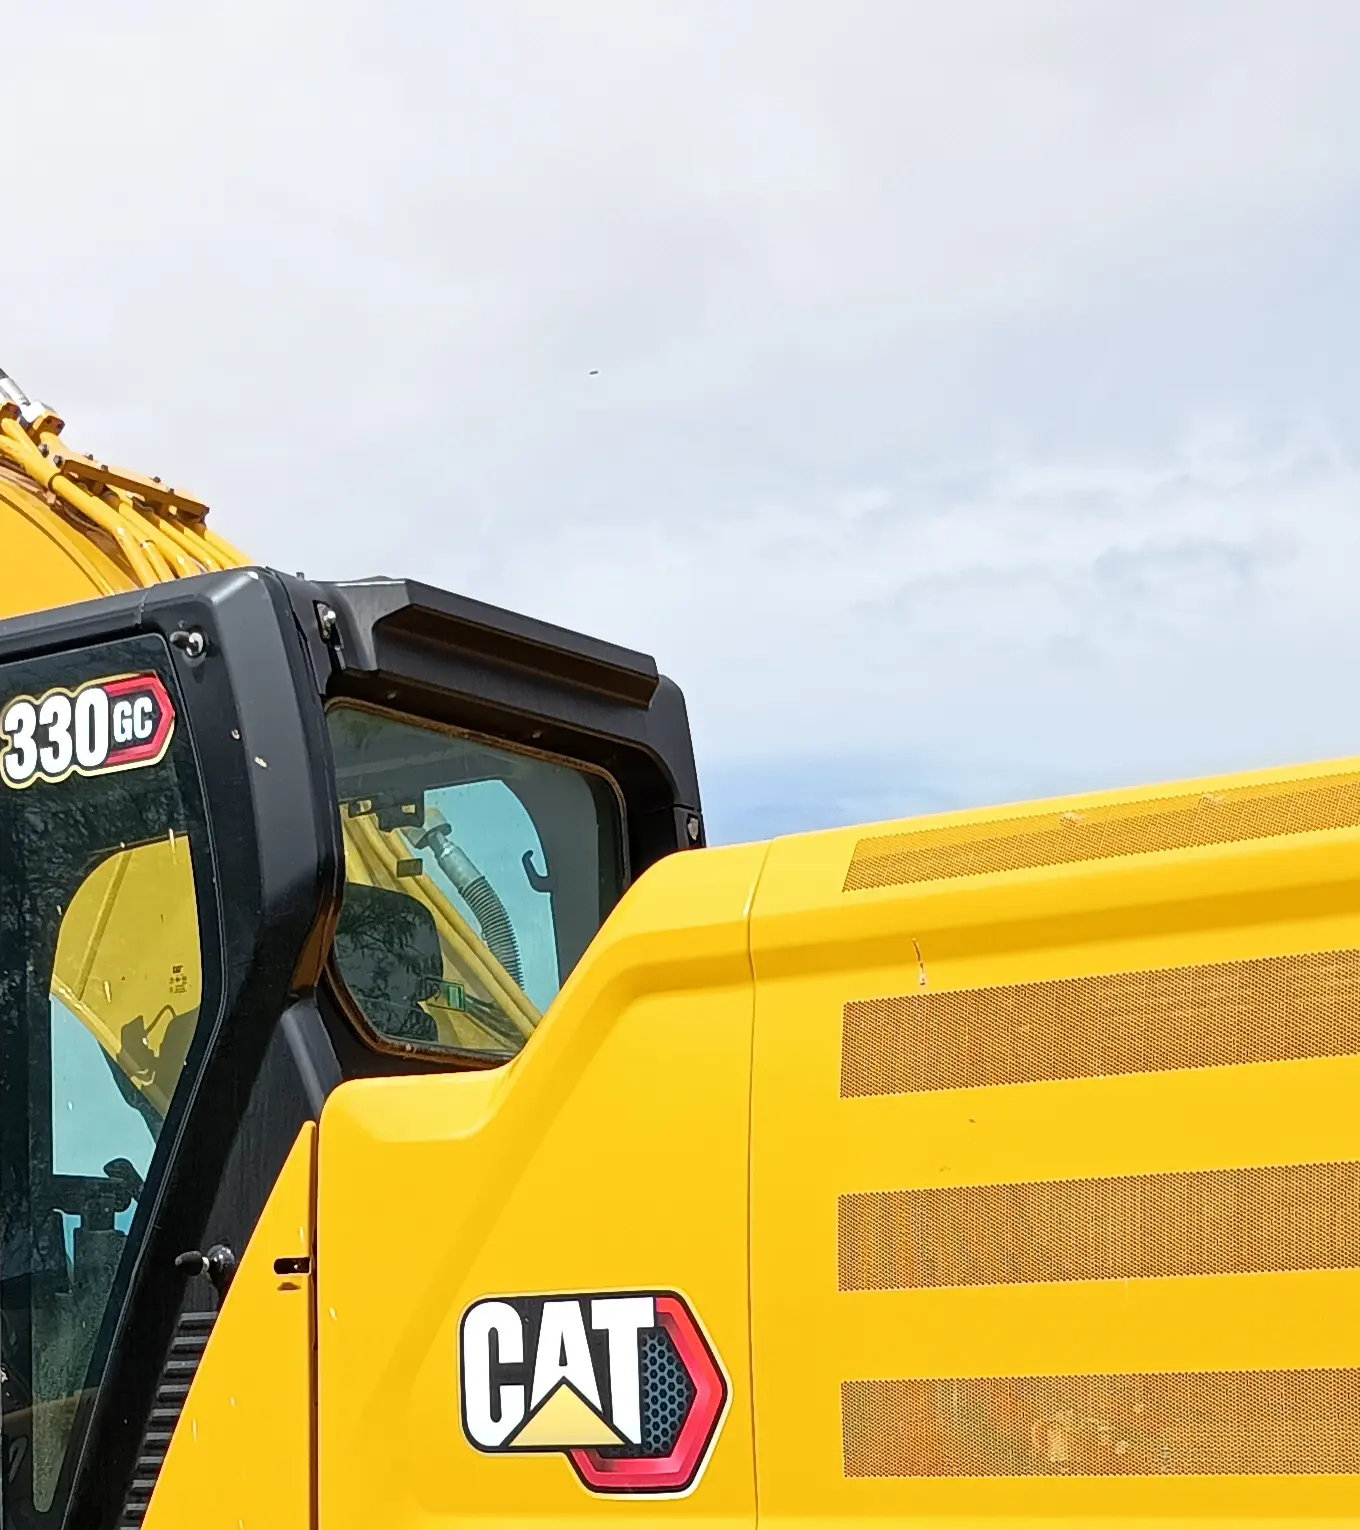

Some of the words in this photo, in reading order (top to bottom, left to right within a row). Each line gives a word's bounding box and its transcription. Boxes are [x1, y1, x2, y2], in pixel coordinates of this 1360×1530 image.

[4, 687, 109, 780] 330
[113, 697, 153, 743] GC
[463, 1297, 655, 1447] CAT
